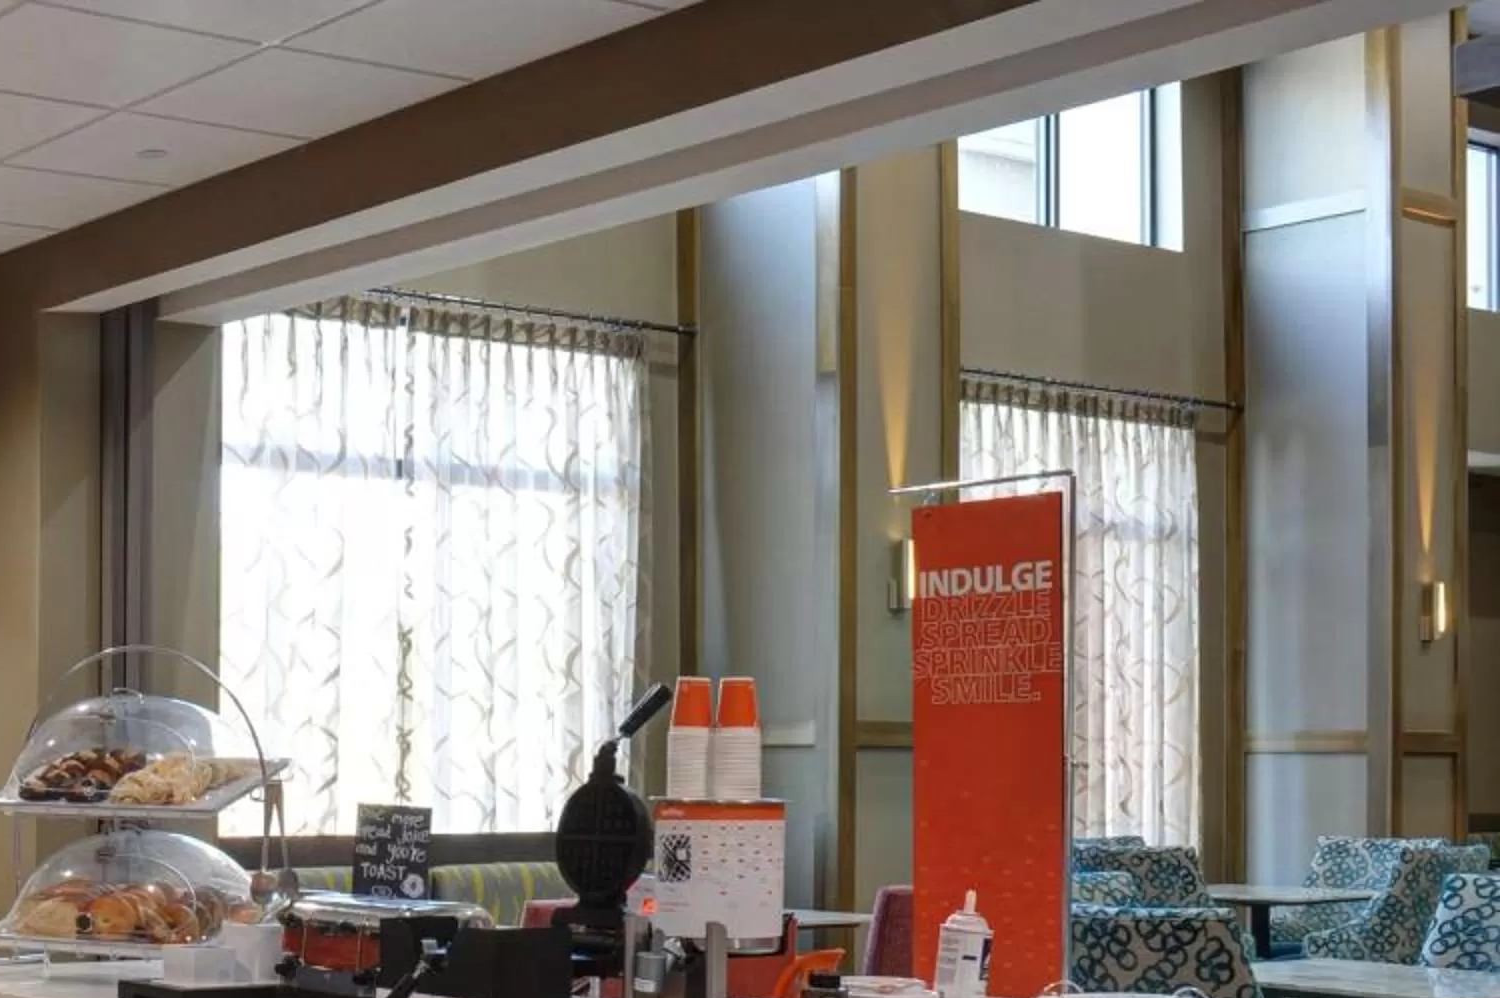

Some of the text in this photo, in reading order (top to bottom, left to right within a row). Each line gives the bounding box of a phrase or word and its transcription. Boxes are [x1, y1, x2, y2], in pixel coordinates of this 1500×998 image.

[919, 560, 1053, 597] INDULGE
[921, 591, 1051, 621] DRIZZLE
[921, 616, 1052, 650] SPREAD
[913, 642, 1062, 679] SPRINKLE
[931, 672, 1041, 705] SMILE.
[360, 862, 408, 880] TOAST
